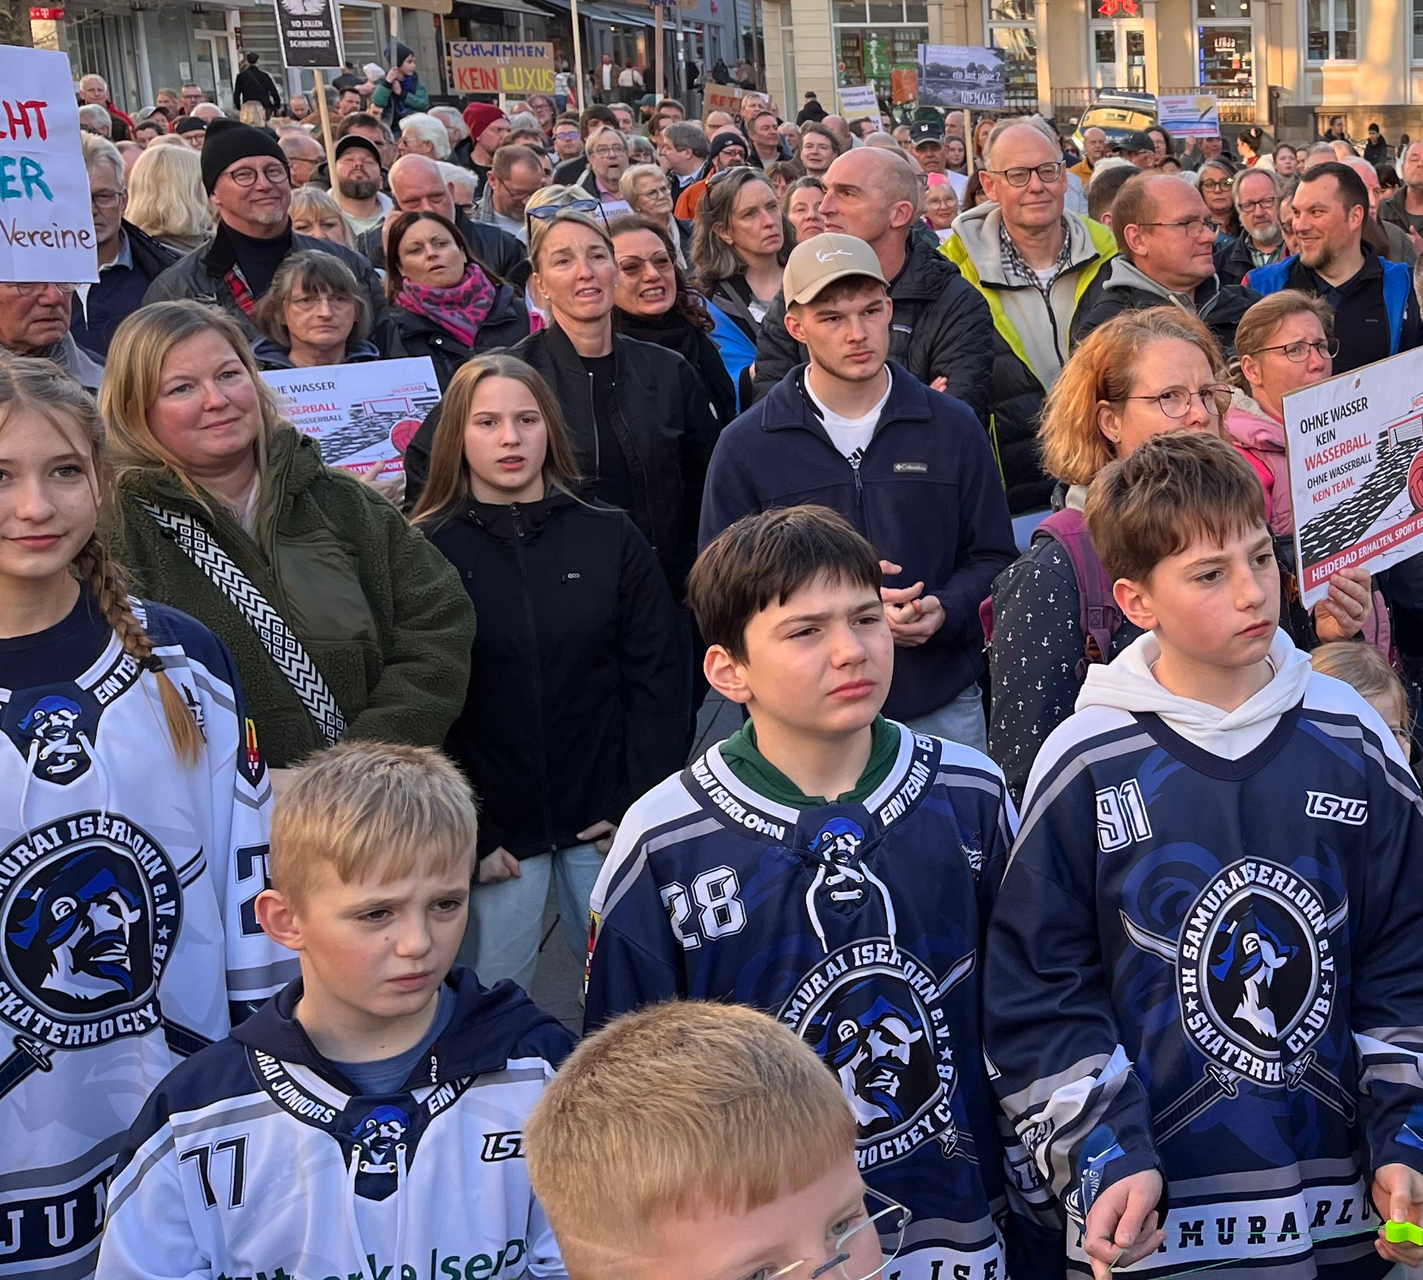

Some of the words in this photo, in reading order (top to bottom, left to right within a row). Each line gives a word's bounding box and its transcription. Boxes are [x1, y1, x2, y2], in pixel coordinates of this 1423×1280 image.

[453, 44, 545, 58] SCHWIMMEN
[496, 56, 510, 64] IST
[458, 67, 498, 91] KEIN
[501, 67, 555, 92] LUXUS
[0, 99, 48, 141] HT
[289, 382, 337, 394] WASSER
[1300, 412, 1330, 435] OHNE
[1330, 397, 1369, 423] WASSER
[1304, 432, 1372, 472] WASSERBALL.
[1316, 428, 1337, 448] KEIN
[1307, 473, 1329, 490] OHNE
[1329, 453, 1373, 482] WASSERBALL
[1312, 486, 1331, 504] KEIN
[1331, 476, 1356, 494] TEAM.
[1311, 550, 1358, 583] HEIDEBAD
[1358, 533, 1394, 560] ERHALTEN.
[1395, 522, 1416, 542] SPORT
[93, 680, 124, 705] EIN
[708, 786, 786, 841] ISERLOHN
[879, 799, 902, 827] EIN
[1096, 778, 1152, 852] 91
[67, 814, 168, 882] ISERLOHN
[659, 864, 748, 951] 28
[1286, 996, 1331, 1055] CLUB
[271, 1079, 337, 1124] JUNIORS
[427, 1081, 456, 1116] EIN
[178, 1133, 249, 1210] 77
